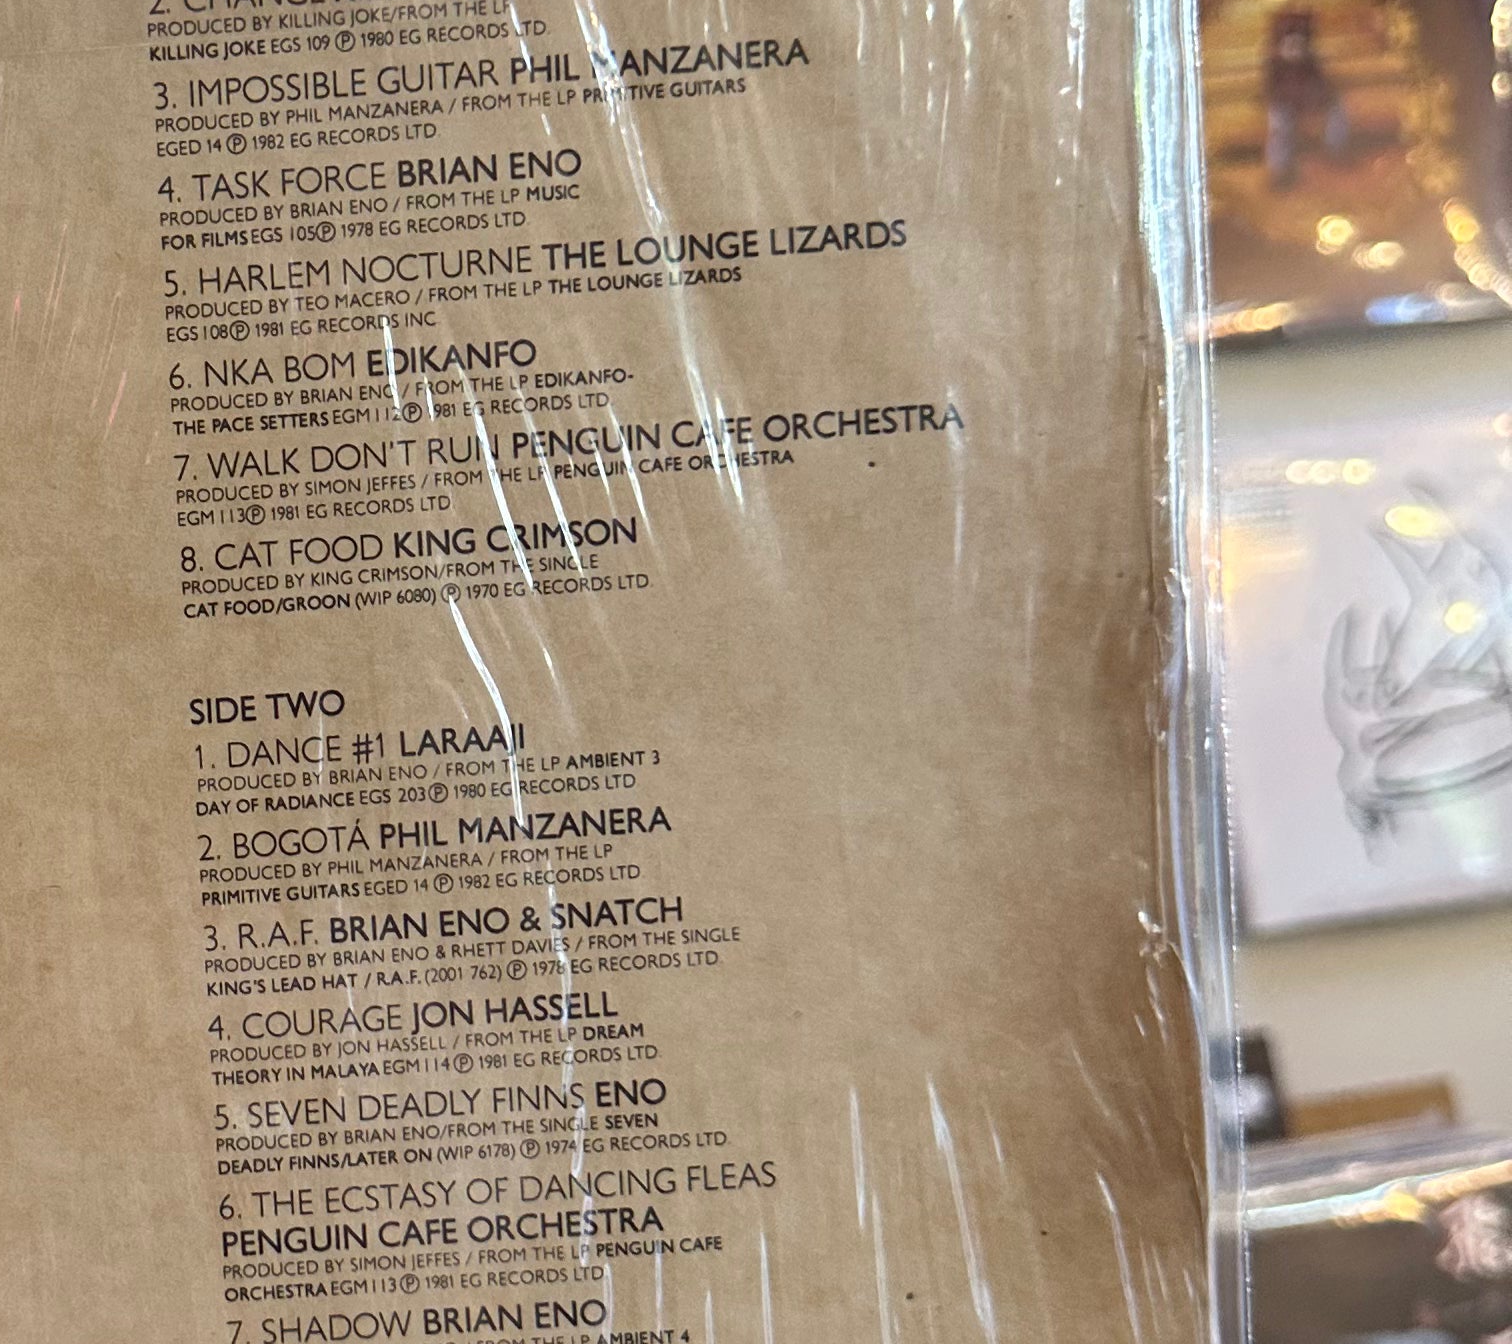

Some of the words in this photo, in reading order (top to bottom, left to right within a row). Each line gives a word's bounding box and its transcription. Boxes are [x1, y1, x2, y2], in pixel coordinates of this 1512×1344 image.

[153, 82, 176, 111] 3.
[189, 68, 366, 108] IMPOSSIBLE
[376, 59, 499, 95] GUITAR
[510, 53, 580, 86] PHIL
[156, 174, 181, 203] 4.
[191, 168, 270, 201] TASK
[280, 160, 386, 195] FORCE
[397, 153, 498, 188] BRIAN
[509, 148, 583, 180] ENO
[159, 205, 258, 228] PRODUCED
[263, 203, 285, 221] BY
[290, 199, 343, 219] BRIAN
[349, 196, 388, 216] ENO
[406, 192, 455, 212] FROM
[461, 189, 495, 208] THE
[500, 187, 520, 206] LP
[526, 183, 581, 204] MUSIC
[163, 268, 186, 297] 5.
[199, 258, 330, 295] HARLEM
[342, 244, 532, 285] NOCTURNE
[541, 239, 606, 272] THE
[617, 229, 760, 266] LOUNGE
[770, 219, 908, 256] LIZARDS
[167, 361, 191, 390] 6.
[203, 356, 274, 388] NKA
[284, 351, 355, 383] BOM
[366, 340, 535, 378] EDIKANFO
[172, 453, 197, 482] 7.
[206, 446, 300, 480] WALK
[310, 438, 418, 473] DON'T
[427, 433, 499, 465] RUN
[512, 422, 661, 460] PENGUIN
[762, 403, 964, 444] ORCHESTRA
[179, 544, 204, 573] 8.
[214, 539, 280, 571] CAT
[290, 532, 384, 566] FOOD
[394, 526, 476, 559] KING
[486, 516, 638, 553] CRIMSON
[189, 694, 257, 726] SIDE
[265, 689, 343, 721] TWO
[193, 741, 215, 770] 1.
[227, 733, 342, 768] DANCE
[351, 731, 384, 761] #1
[197, 832, 220, 861] 2.
[233, 820, 370, 859] BOGOTÁ
[380, 818, 448, 850] PHIL
[458, 804, 670, 845] MANZANERA
[199, 861, 296, 883] PRODUCED
[302, 859, 322, 877] BY
[328, 857, 363, 876] PHIL
[370, 849, 482, 873] MANZANERA
[501, 845, 549, 865] FROM
[555, 843, 588, 862] THE
[594, 842, 613, 860] LP
[203, 923, 226, 952] 3.
[238, 917, 318, 950] R.A.F.
[330, 911, 428, 944] BRIAN
[439, 905, 511, 938] ENO
[519, 904, 542, 933] &
[551, 895, 683, 931] SNATCH
[206, 1012, 231, 1042] 4.
[241, 1003, 402, 1040] COURAGE
[413, 998, 474, 1033] JON
[485, 990, 620, 1026] HASSELL
[214, 1102, 237, 1131] 5.
[248, 1096, 346, 1129] SEVEN
[359, 1088, 482, 1123] DEADLY
[493, 1083, 584, 1115] FINNS
[596, 1078, 667, 1110] ENO
[217, 1192, 242, 1221] 6.
[251, 1187, 314, 1219] THE
[325, 1179, 458, 1215] ECSTASY
[466, 1176, 510, 1207] OF
[520, 1167, 677, 1203] DANCING
[687, 1161, 777, 1194] FLEAS
[222, 1222, 367, 1258] PENGUIN
[378, 1217, 458, 1249] CAFE
[467, 1205, 662, 1244] ORCHESTRA
[222, 1257, 319, 1279] PRODUCED
[324, 1256, 344, 1274] BY
[349, 1252, 406, 1272] SIMON
[411, 1249, 460, 1269] JEFFES
[478, 1246, 526, 1265] FROM
[531, 1244, 564, 1262] THE
[595, 1238, 675, 1259] PENGUIN
[679, 1235, 723, 1254] CAFE
[424, 1304, 523, 1337] BRIAN
[535, 1299, 608, 1331] ENO
